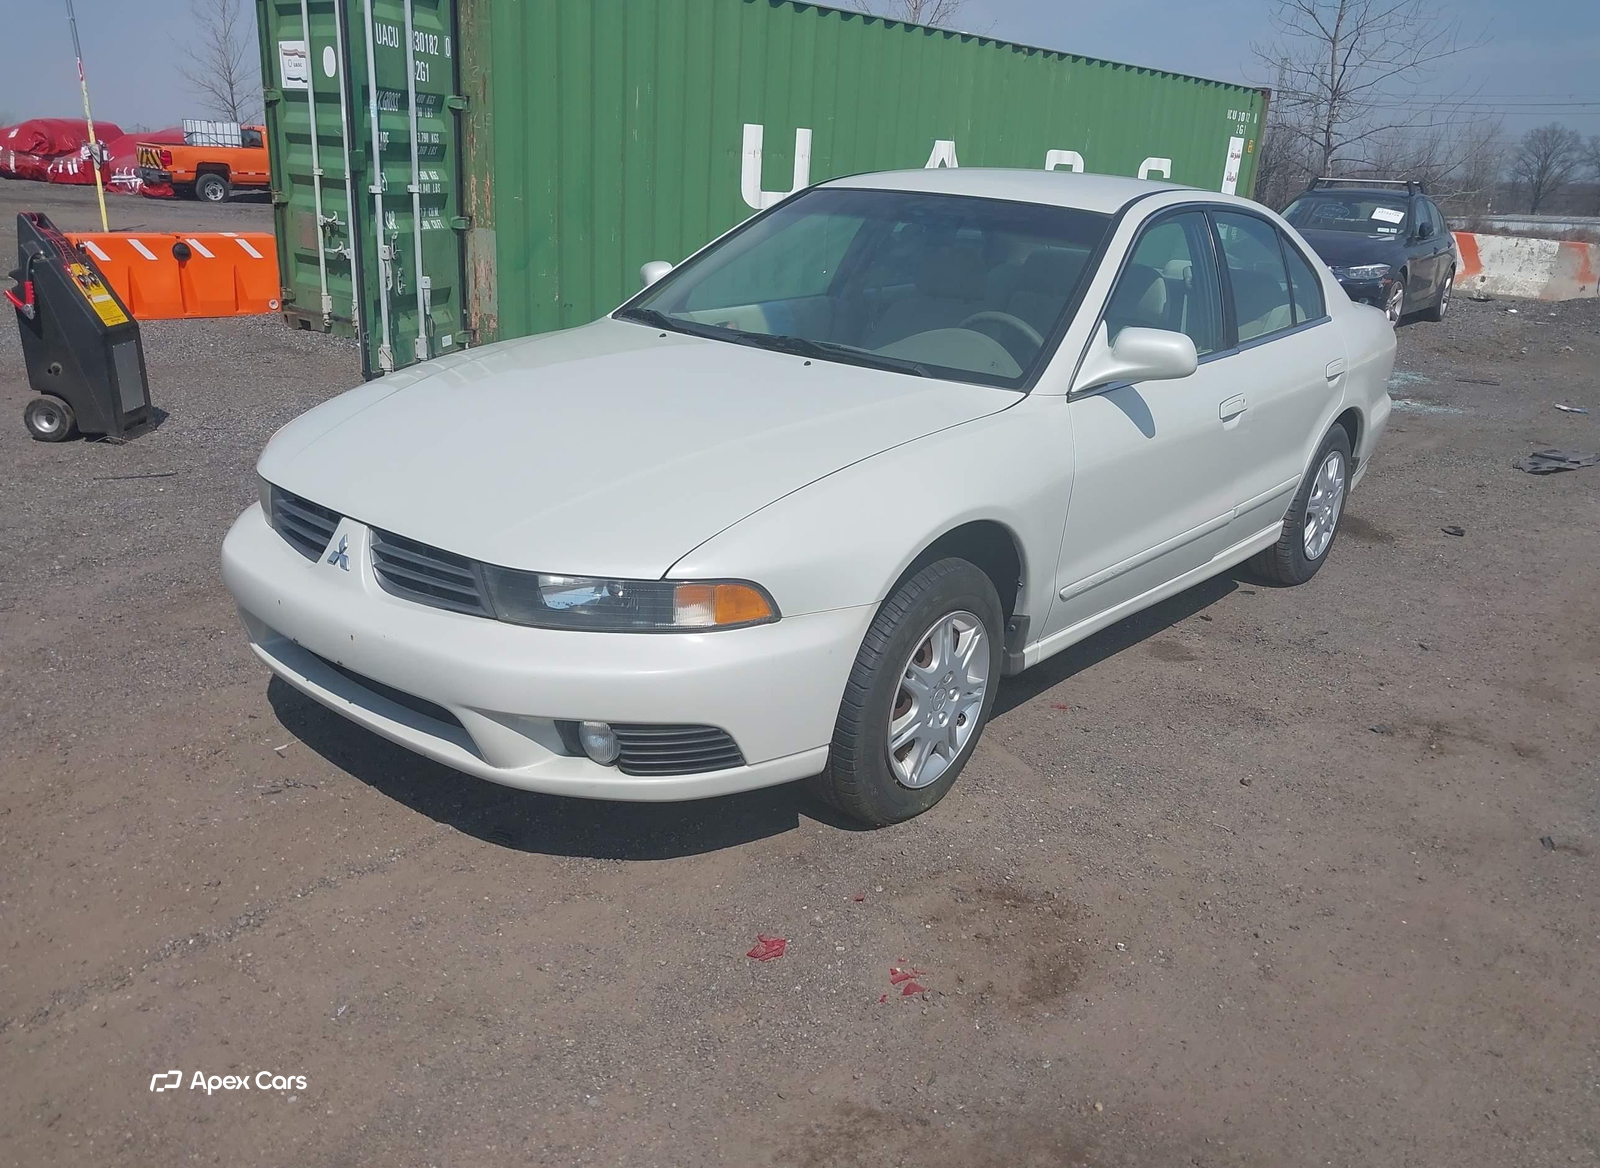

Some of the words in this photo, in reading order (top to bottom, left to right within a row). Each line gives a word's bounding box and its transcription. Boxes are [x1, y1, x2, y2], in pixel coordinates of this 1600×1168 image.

[375, 22, 399, 48] UACU
[445, 36, 451, 57] 0
[415, 60, 429, 82] 2G1
